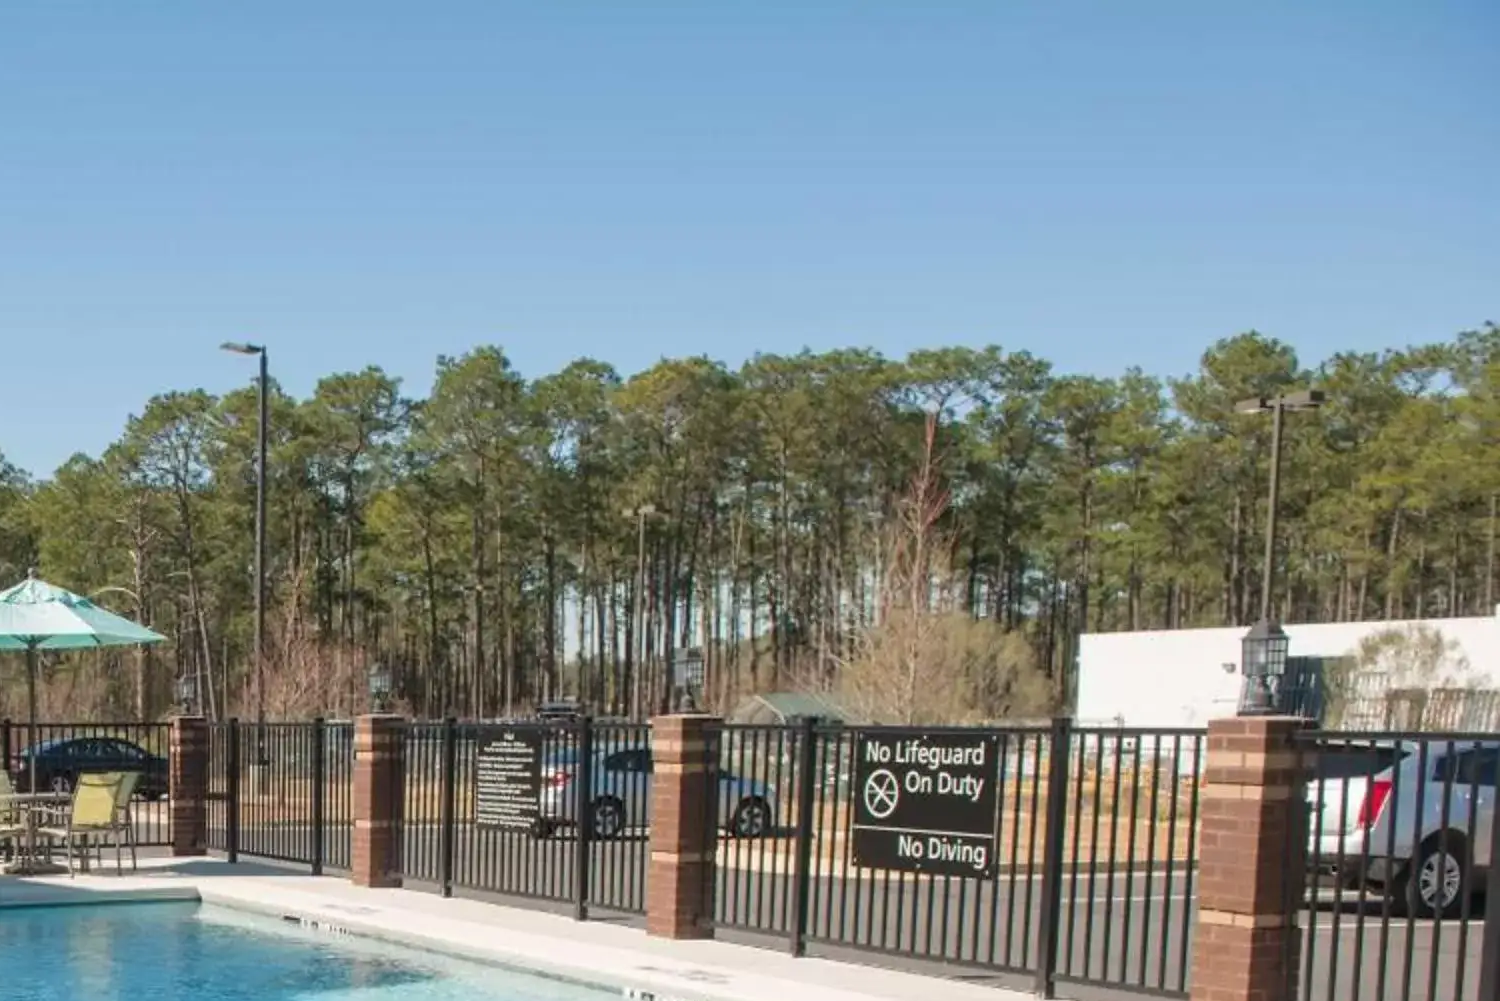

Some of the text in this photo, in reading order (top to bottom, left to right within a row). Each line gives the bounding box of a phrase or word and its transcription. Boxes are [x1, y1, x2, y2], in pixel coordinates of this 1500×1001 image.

[866, 741, 985, 770] No Lifeguard
[905, 771, 984, 801] On Duty
[898, 836, 987, 869] No Diving
